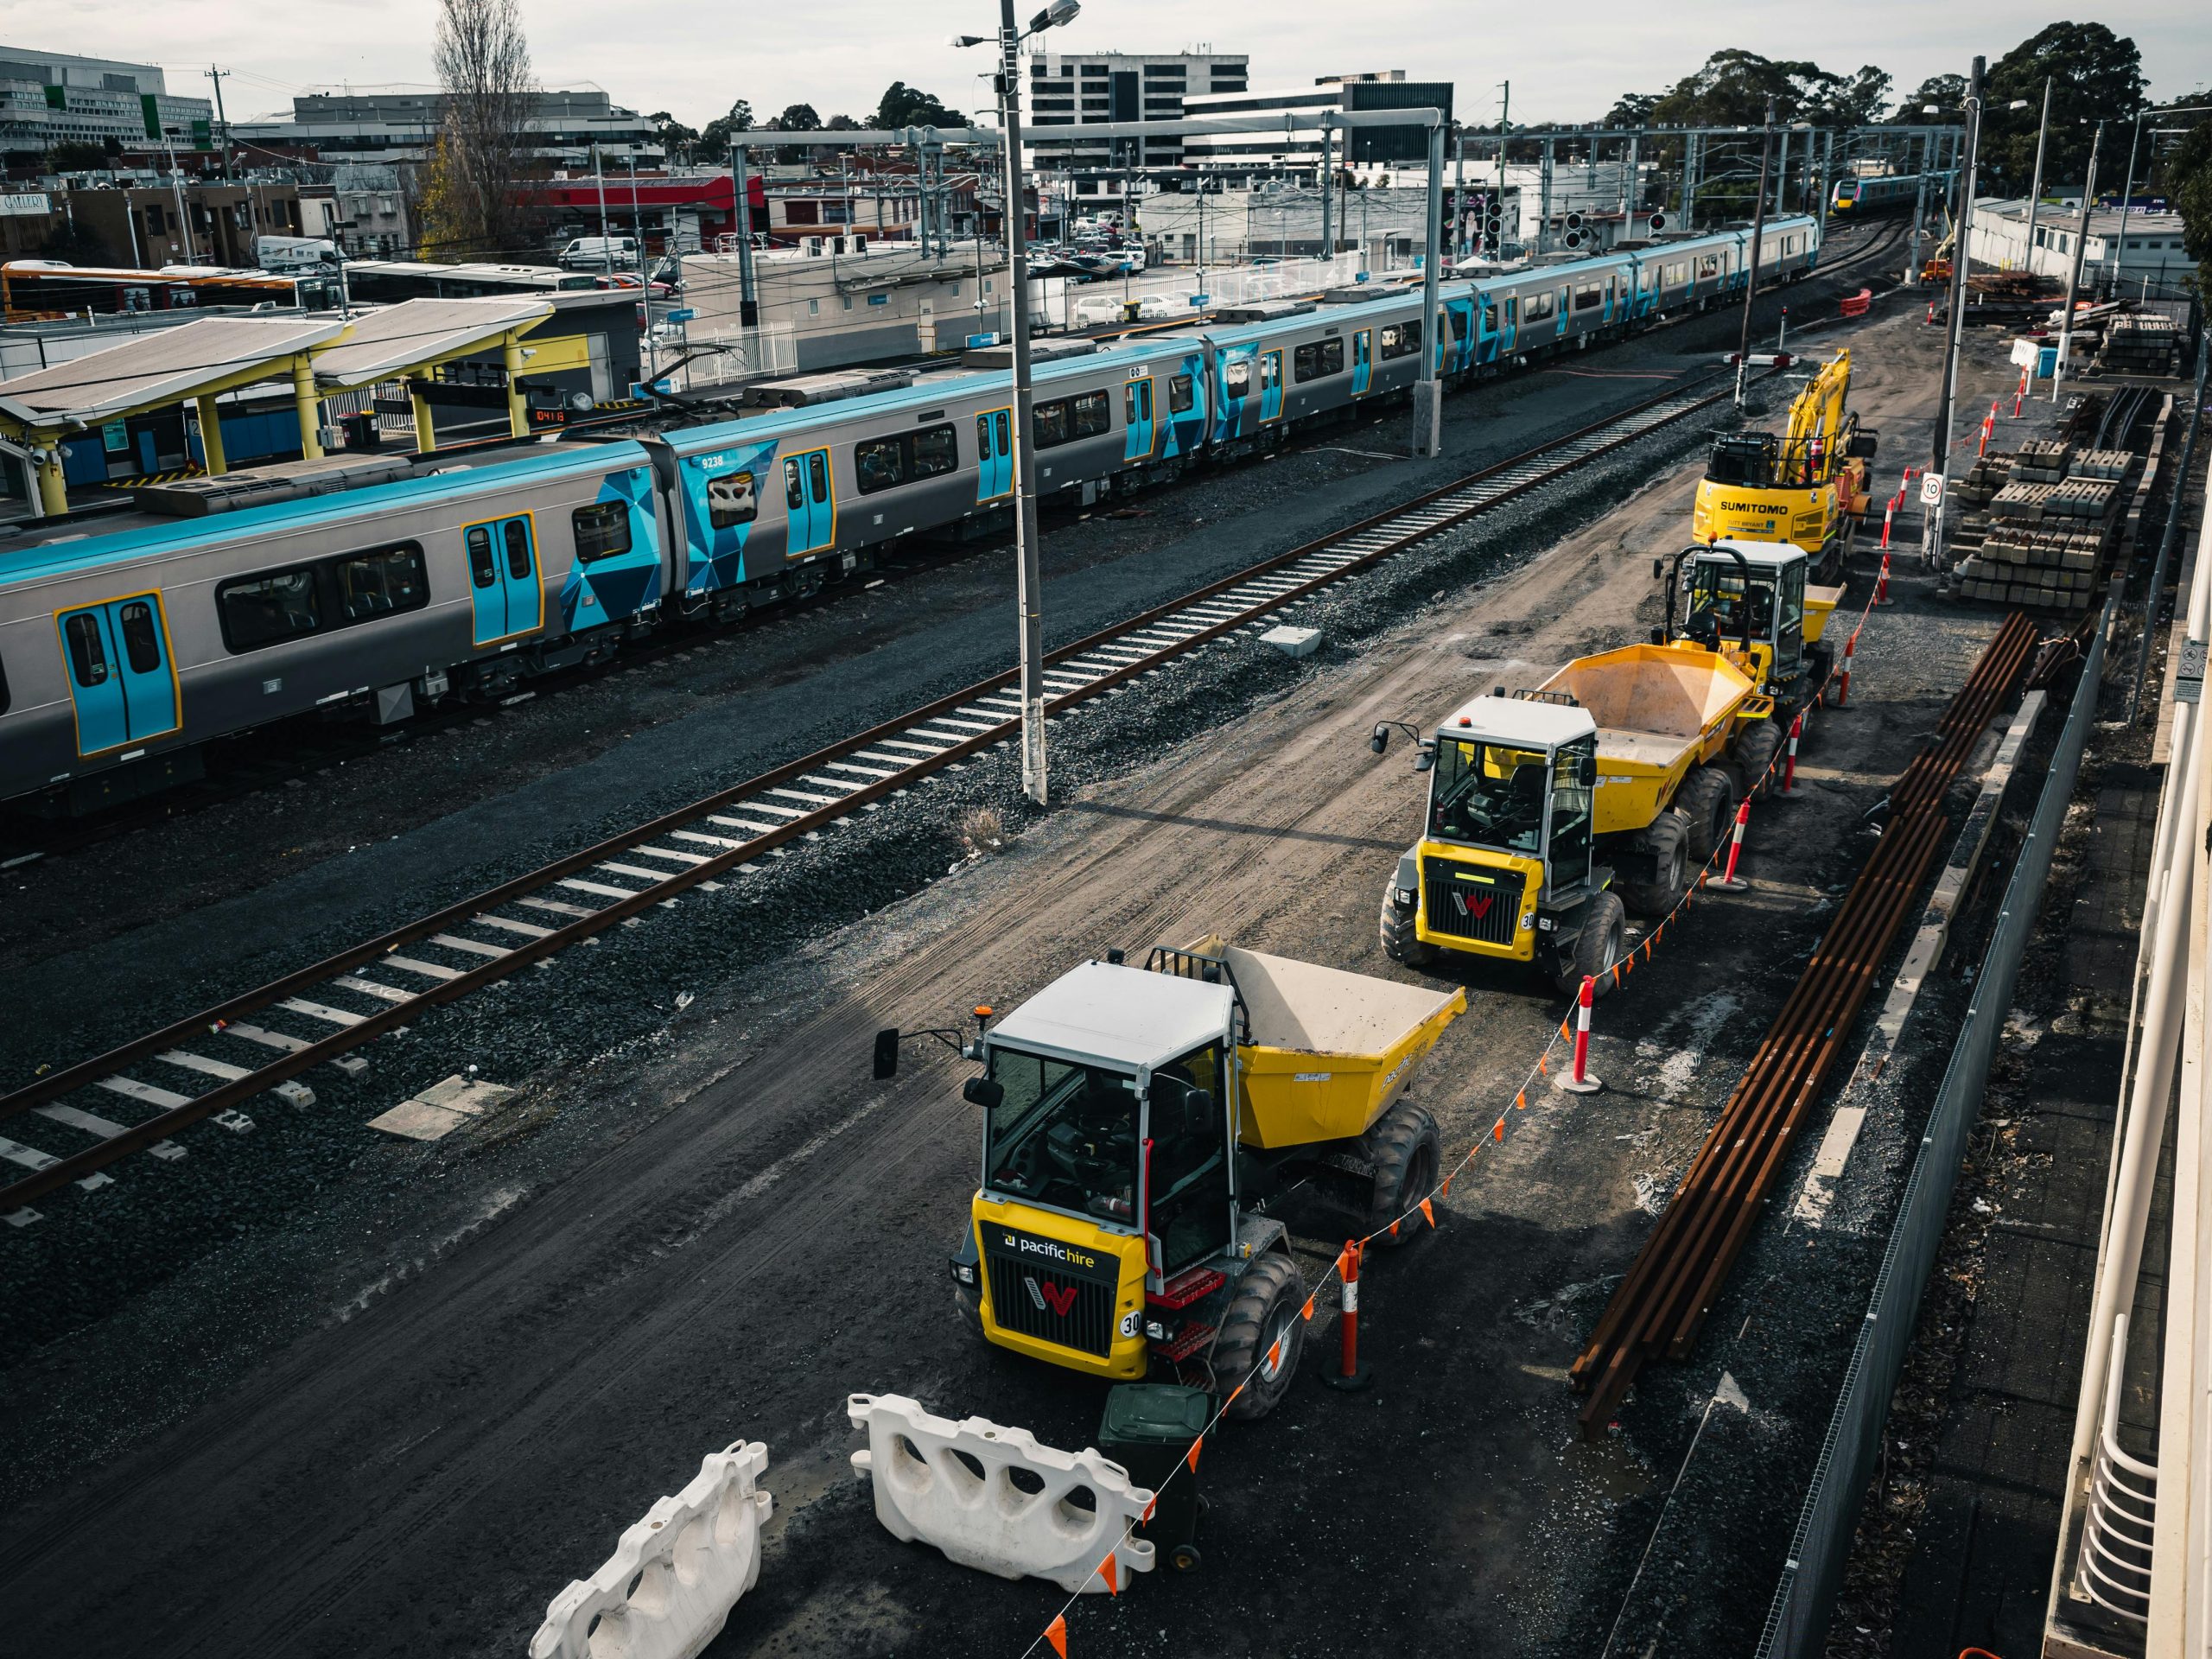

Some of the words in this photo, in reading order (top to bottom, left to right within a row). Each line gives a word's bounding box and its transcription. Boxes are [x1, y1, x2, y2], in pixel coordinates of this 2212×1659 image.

[4, 195, 44, 208] GALLERY
[702, 455, 724, 469] 9238
[1927, 483, 1938, 494] 10
[1720, 501, 1789, 515] SUMITOMO
[1523, 914, 1534, 928] 30
[1124, 1313, 1140, 1334] 30
